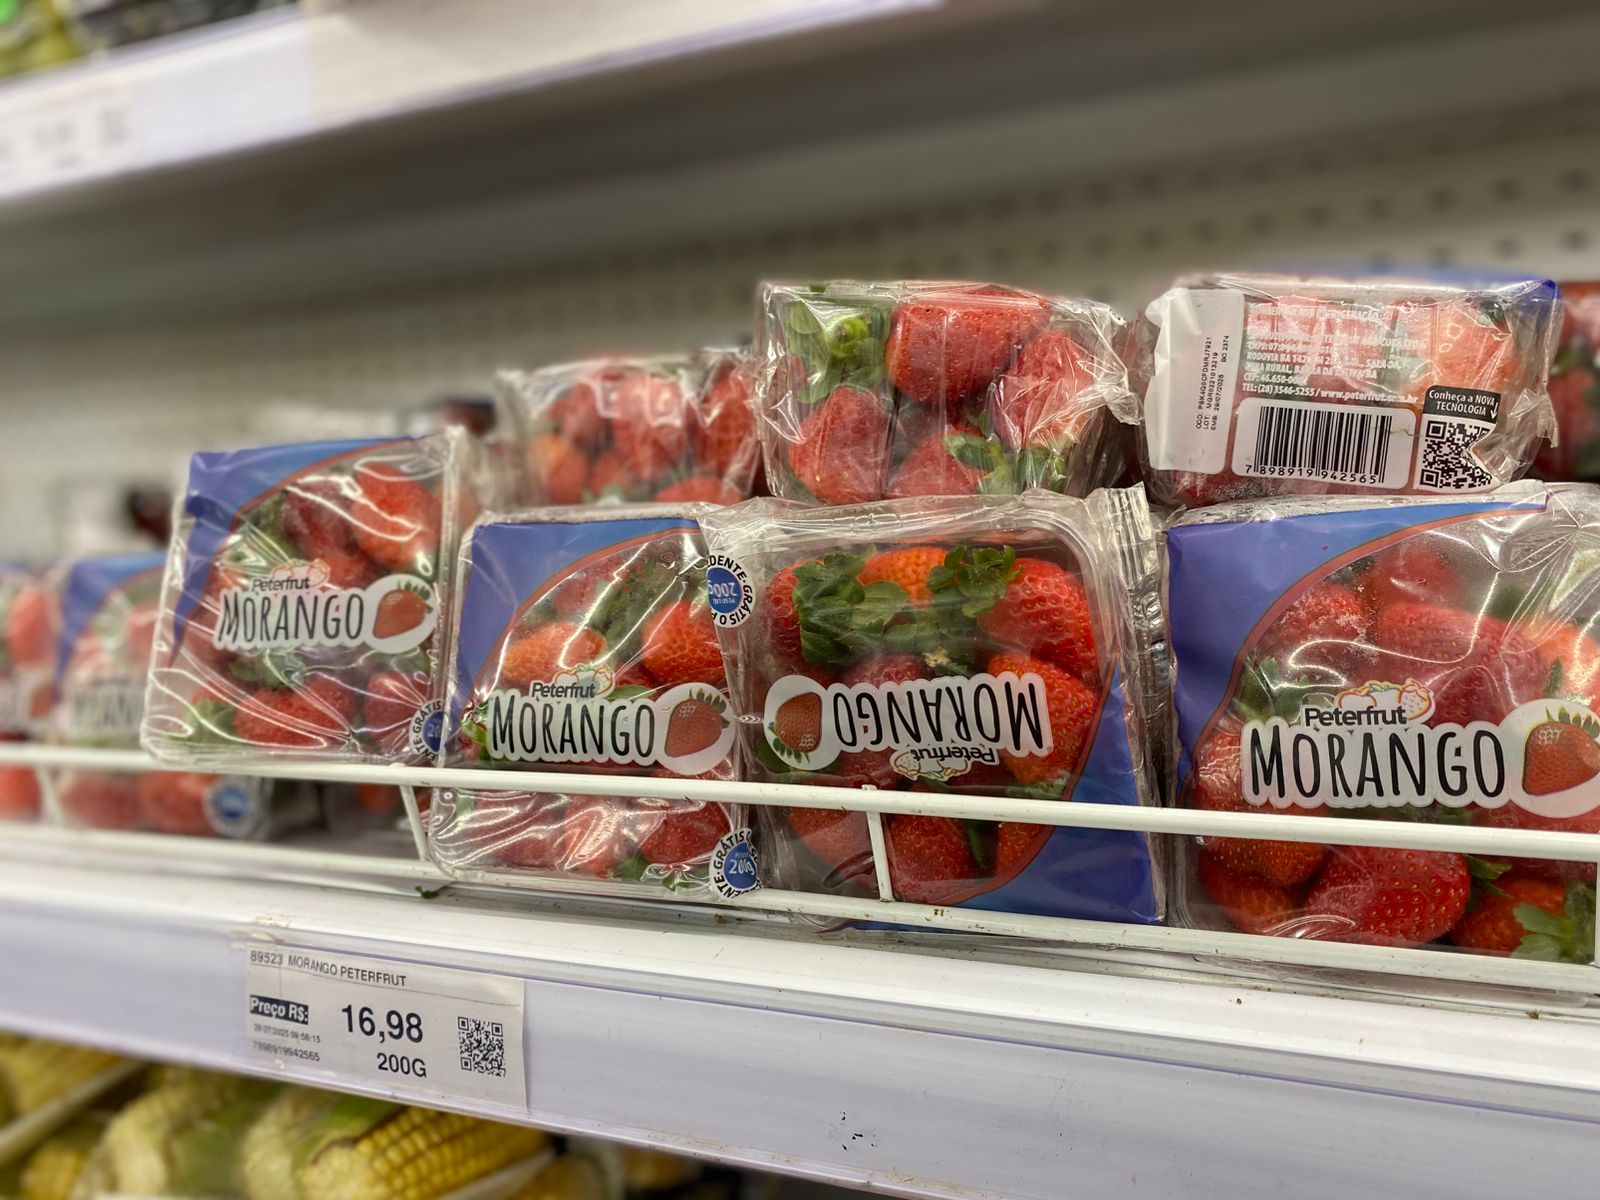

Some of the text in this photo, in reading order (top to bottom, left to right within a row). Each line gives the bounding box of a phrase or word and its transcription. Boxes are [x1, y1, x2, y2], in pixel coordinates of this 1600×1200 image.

[1243, 372, 1260, 383] CEP:
[1265, 363, 1293, 375] RURAL,
[1242, 382, 1257, 393] TEL:
[1257, 383, 1273, 395] (28)
[1273, 385, 1315, 397] 3546-5255
[1429, 389, 1466, 403] Conheça
[1475, 394, 1496, 407] NOVA
[1436, 400, 1487, 416] TECNOLOGIA
[1259, 466, 1314, 478] 898919
[1321, 470, 1376, 484] 942565
[252, 576, 311, 592] Peterfrut
[729, 584, 754, 626] GRÁTIS
[217, 591, 365, 644] MORANGO
[532, 682, 596, 698] Peterfrut
[412, 700, 442, 734] GRÁTIS
[492, 694, 655, 758] MORANGO
[833, 680, 1044, 751] MORANGO
[1304, 705, 1408, 727] Peterfrut
[911, 746, 996, 763] Peterfrut
[1250, 724, 1506, 799] MORANGO
[713, 830, 745, 870] GRÁTIS
[250, 950, 407, 987] 89523 MORANGO PETERFRUT
[250, 997, 287, 1018] Preço
[341, 1003, 424, 1043] 16,98
[377, 1052, 427, 1078] 200G
